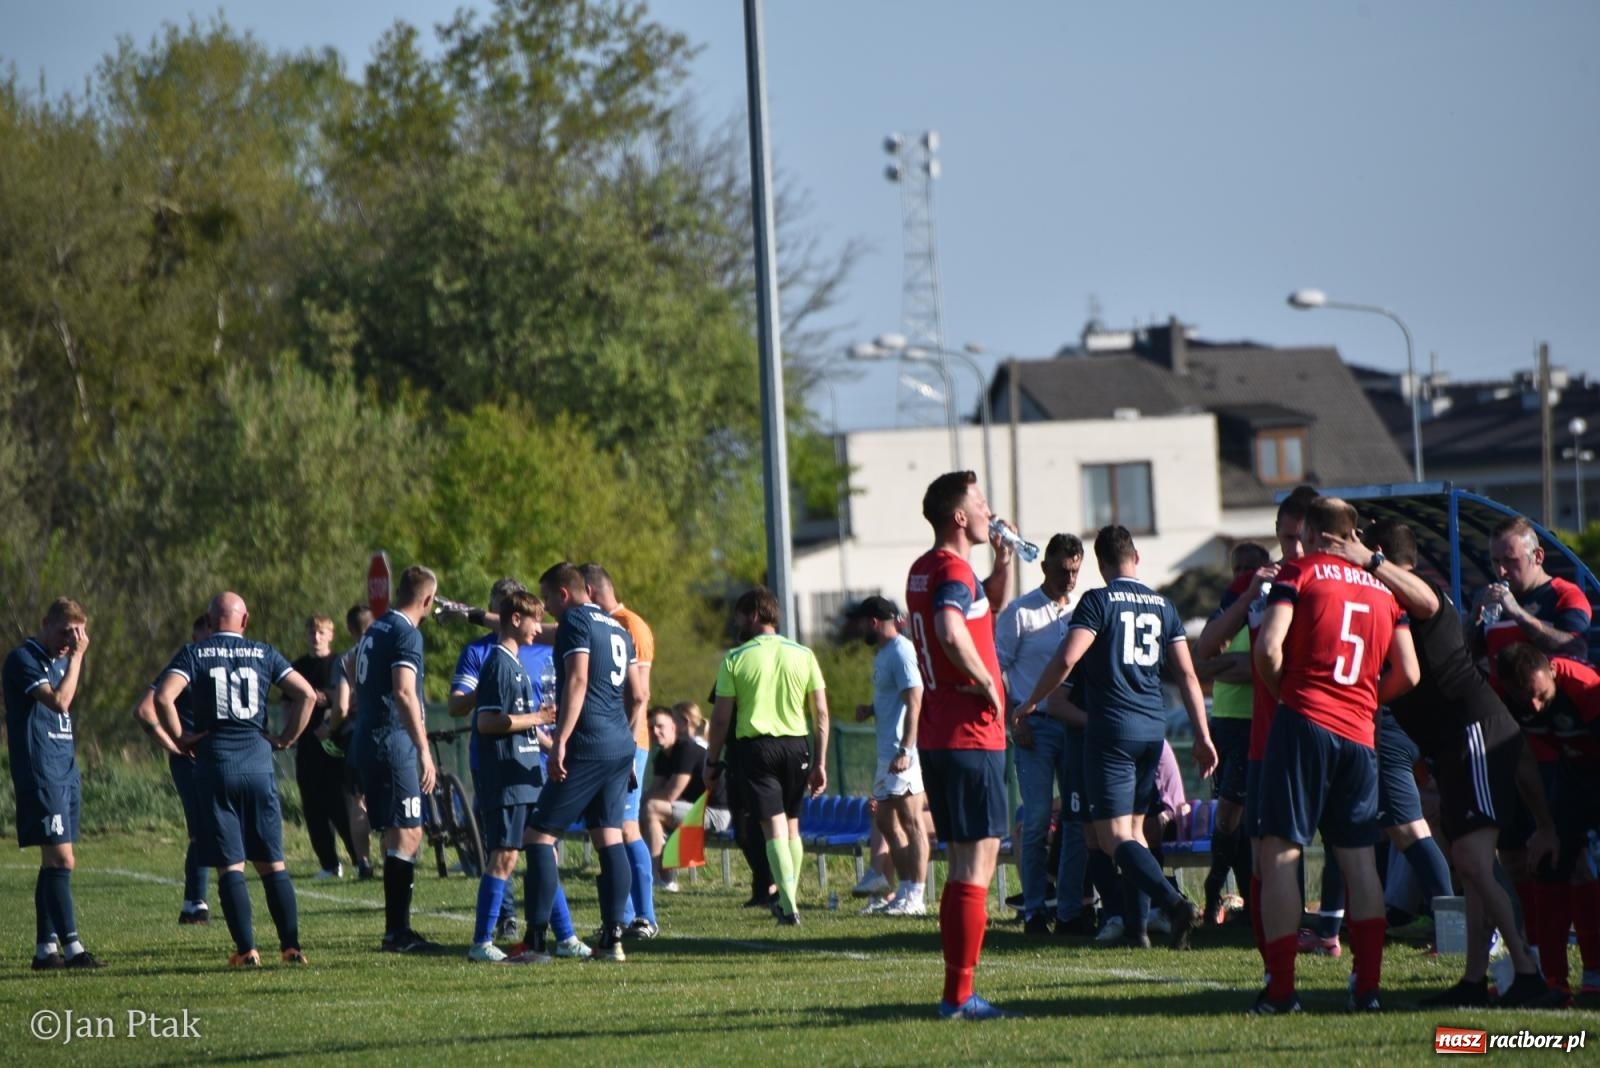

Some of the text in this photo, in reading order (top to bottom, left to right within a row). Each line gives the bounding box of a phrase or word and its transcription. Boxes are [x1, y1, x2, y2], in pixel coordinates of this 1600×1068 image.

[1314, 563, 1392, 596] LKS BRZE
[610, 633, 627, 687] 9
[1120, 611, 1161, 667] 13
[1333, 601, 1370, 686] 5
[209, 666, 259, 720] 10
[401, 796, 421, 818] 16
[1071, 791, 1080, 813] 6
[41, 813, 65, 837] 14
